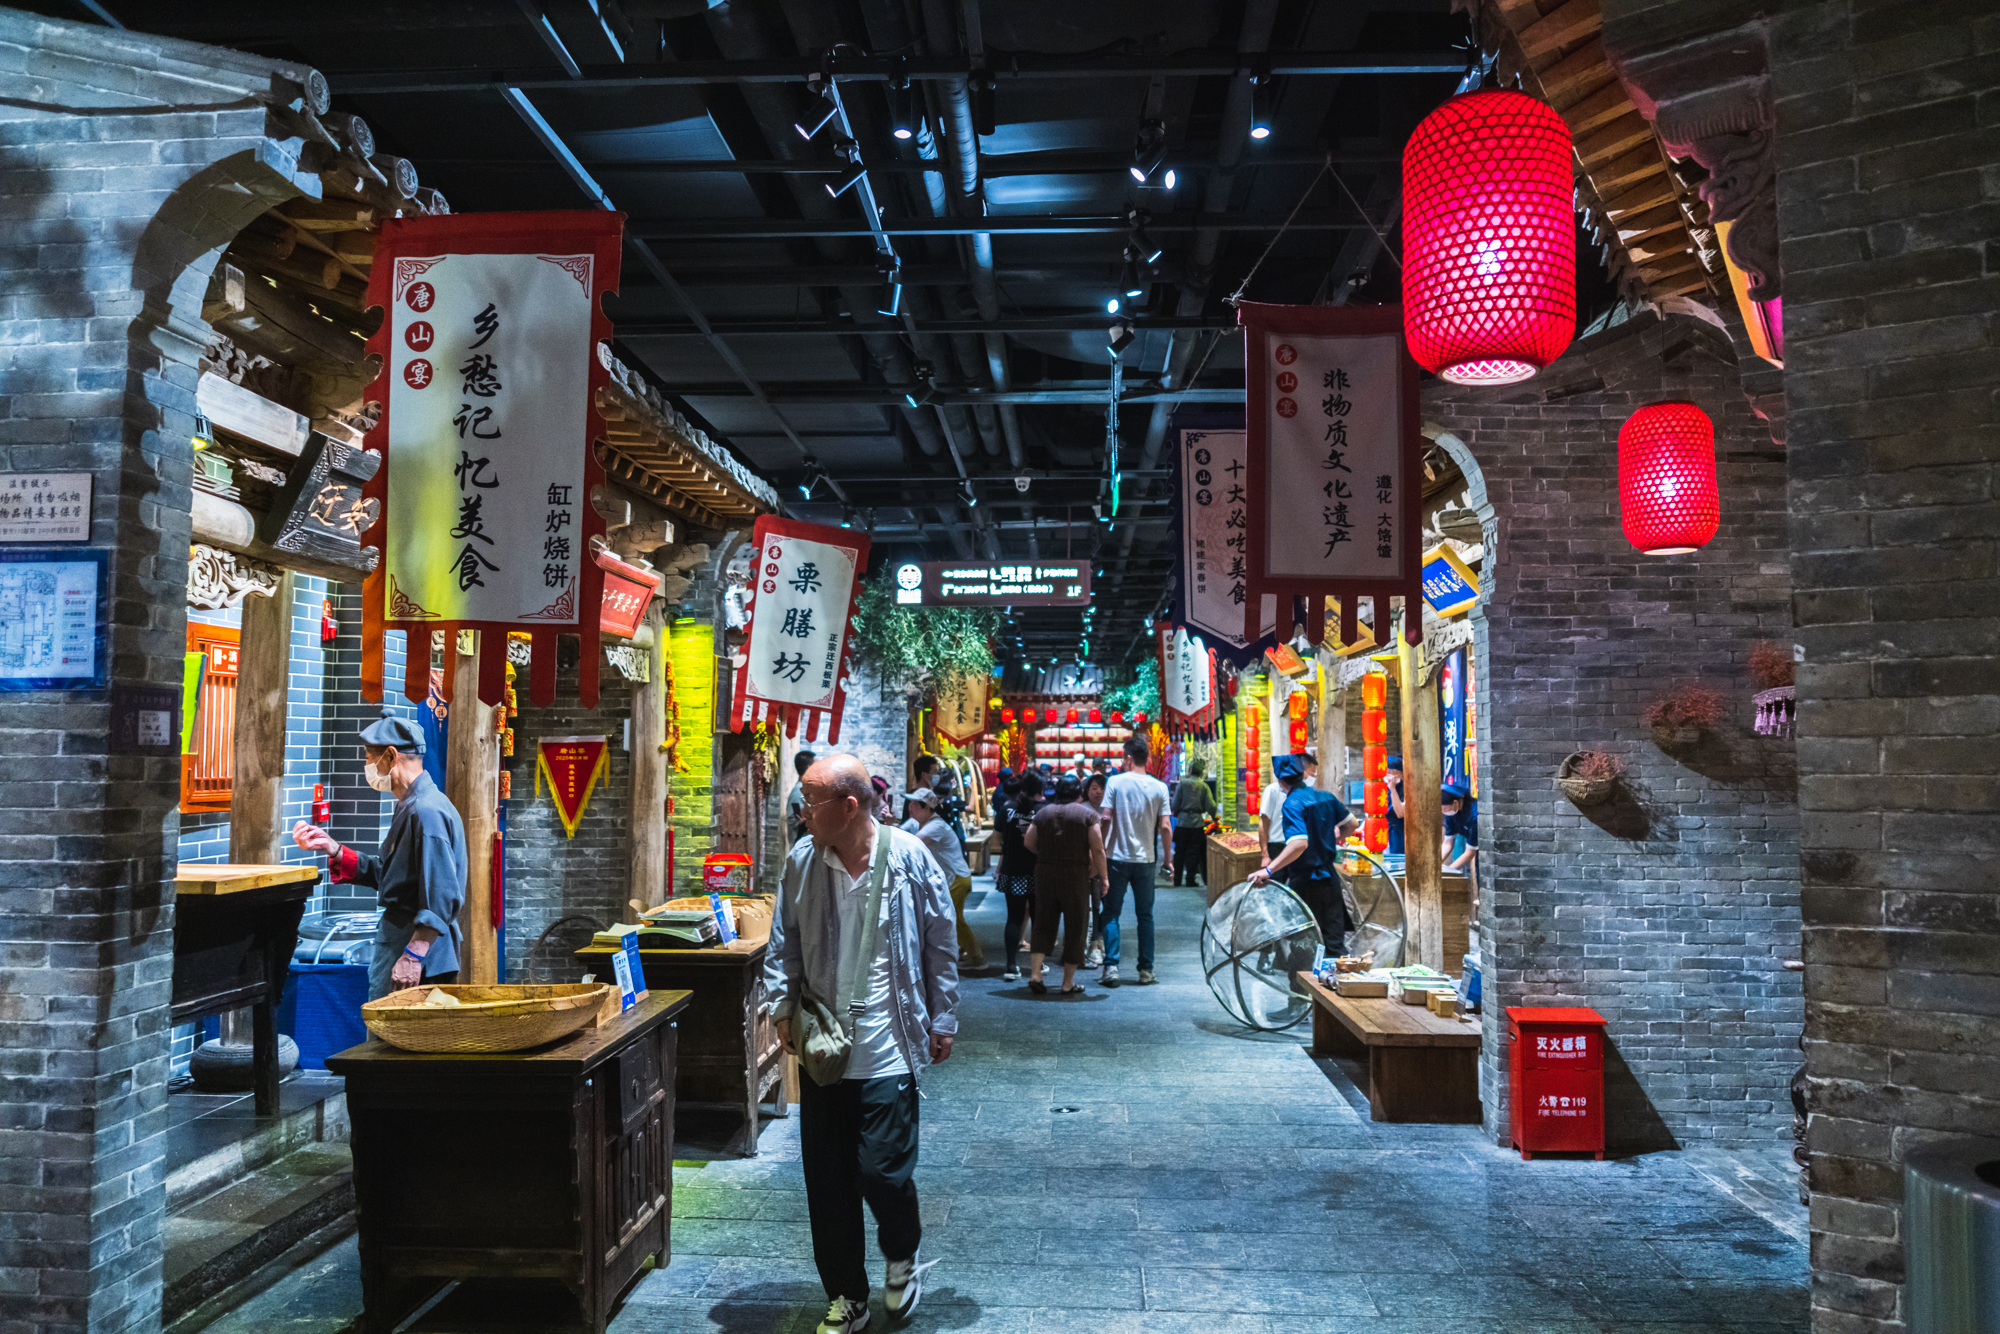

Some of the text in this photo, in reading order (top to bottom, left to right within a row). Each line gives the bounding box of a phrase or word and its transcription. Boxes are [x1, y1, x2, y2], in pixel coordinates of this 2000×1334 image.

[405, 283, 433, 387] 唐山宴
[1277, 346, 1297, 416] 唐山宴
[449, 302, 502, 592] 乡愁记忆美食
[1196, 450, 1211, 505] 唐山宴
[1321, 368, 1355, 558] 非物质文化遗产
[1376, 475, 1393, 504] 遵化
[542, 482, 573, 588] 缸炉烧饼
[1224, 459, 1246, 605] 十大必吃美食
[764, 547, 781, 593] 唐山宴
[772, 562, 822, 683] 栗膳坊
[821, 633, 838, 689] 正宗迁西板栗
[1537, 1036, 1586, 1051] 灭火器箱
[1539, 1095, 1587, 1108] 火警 119
